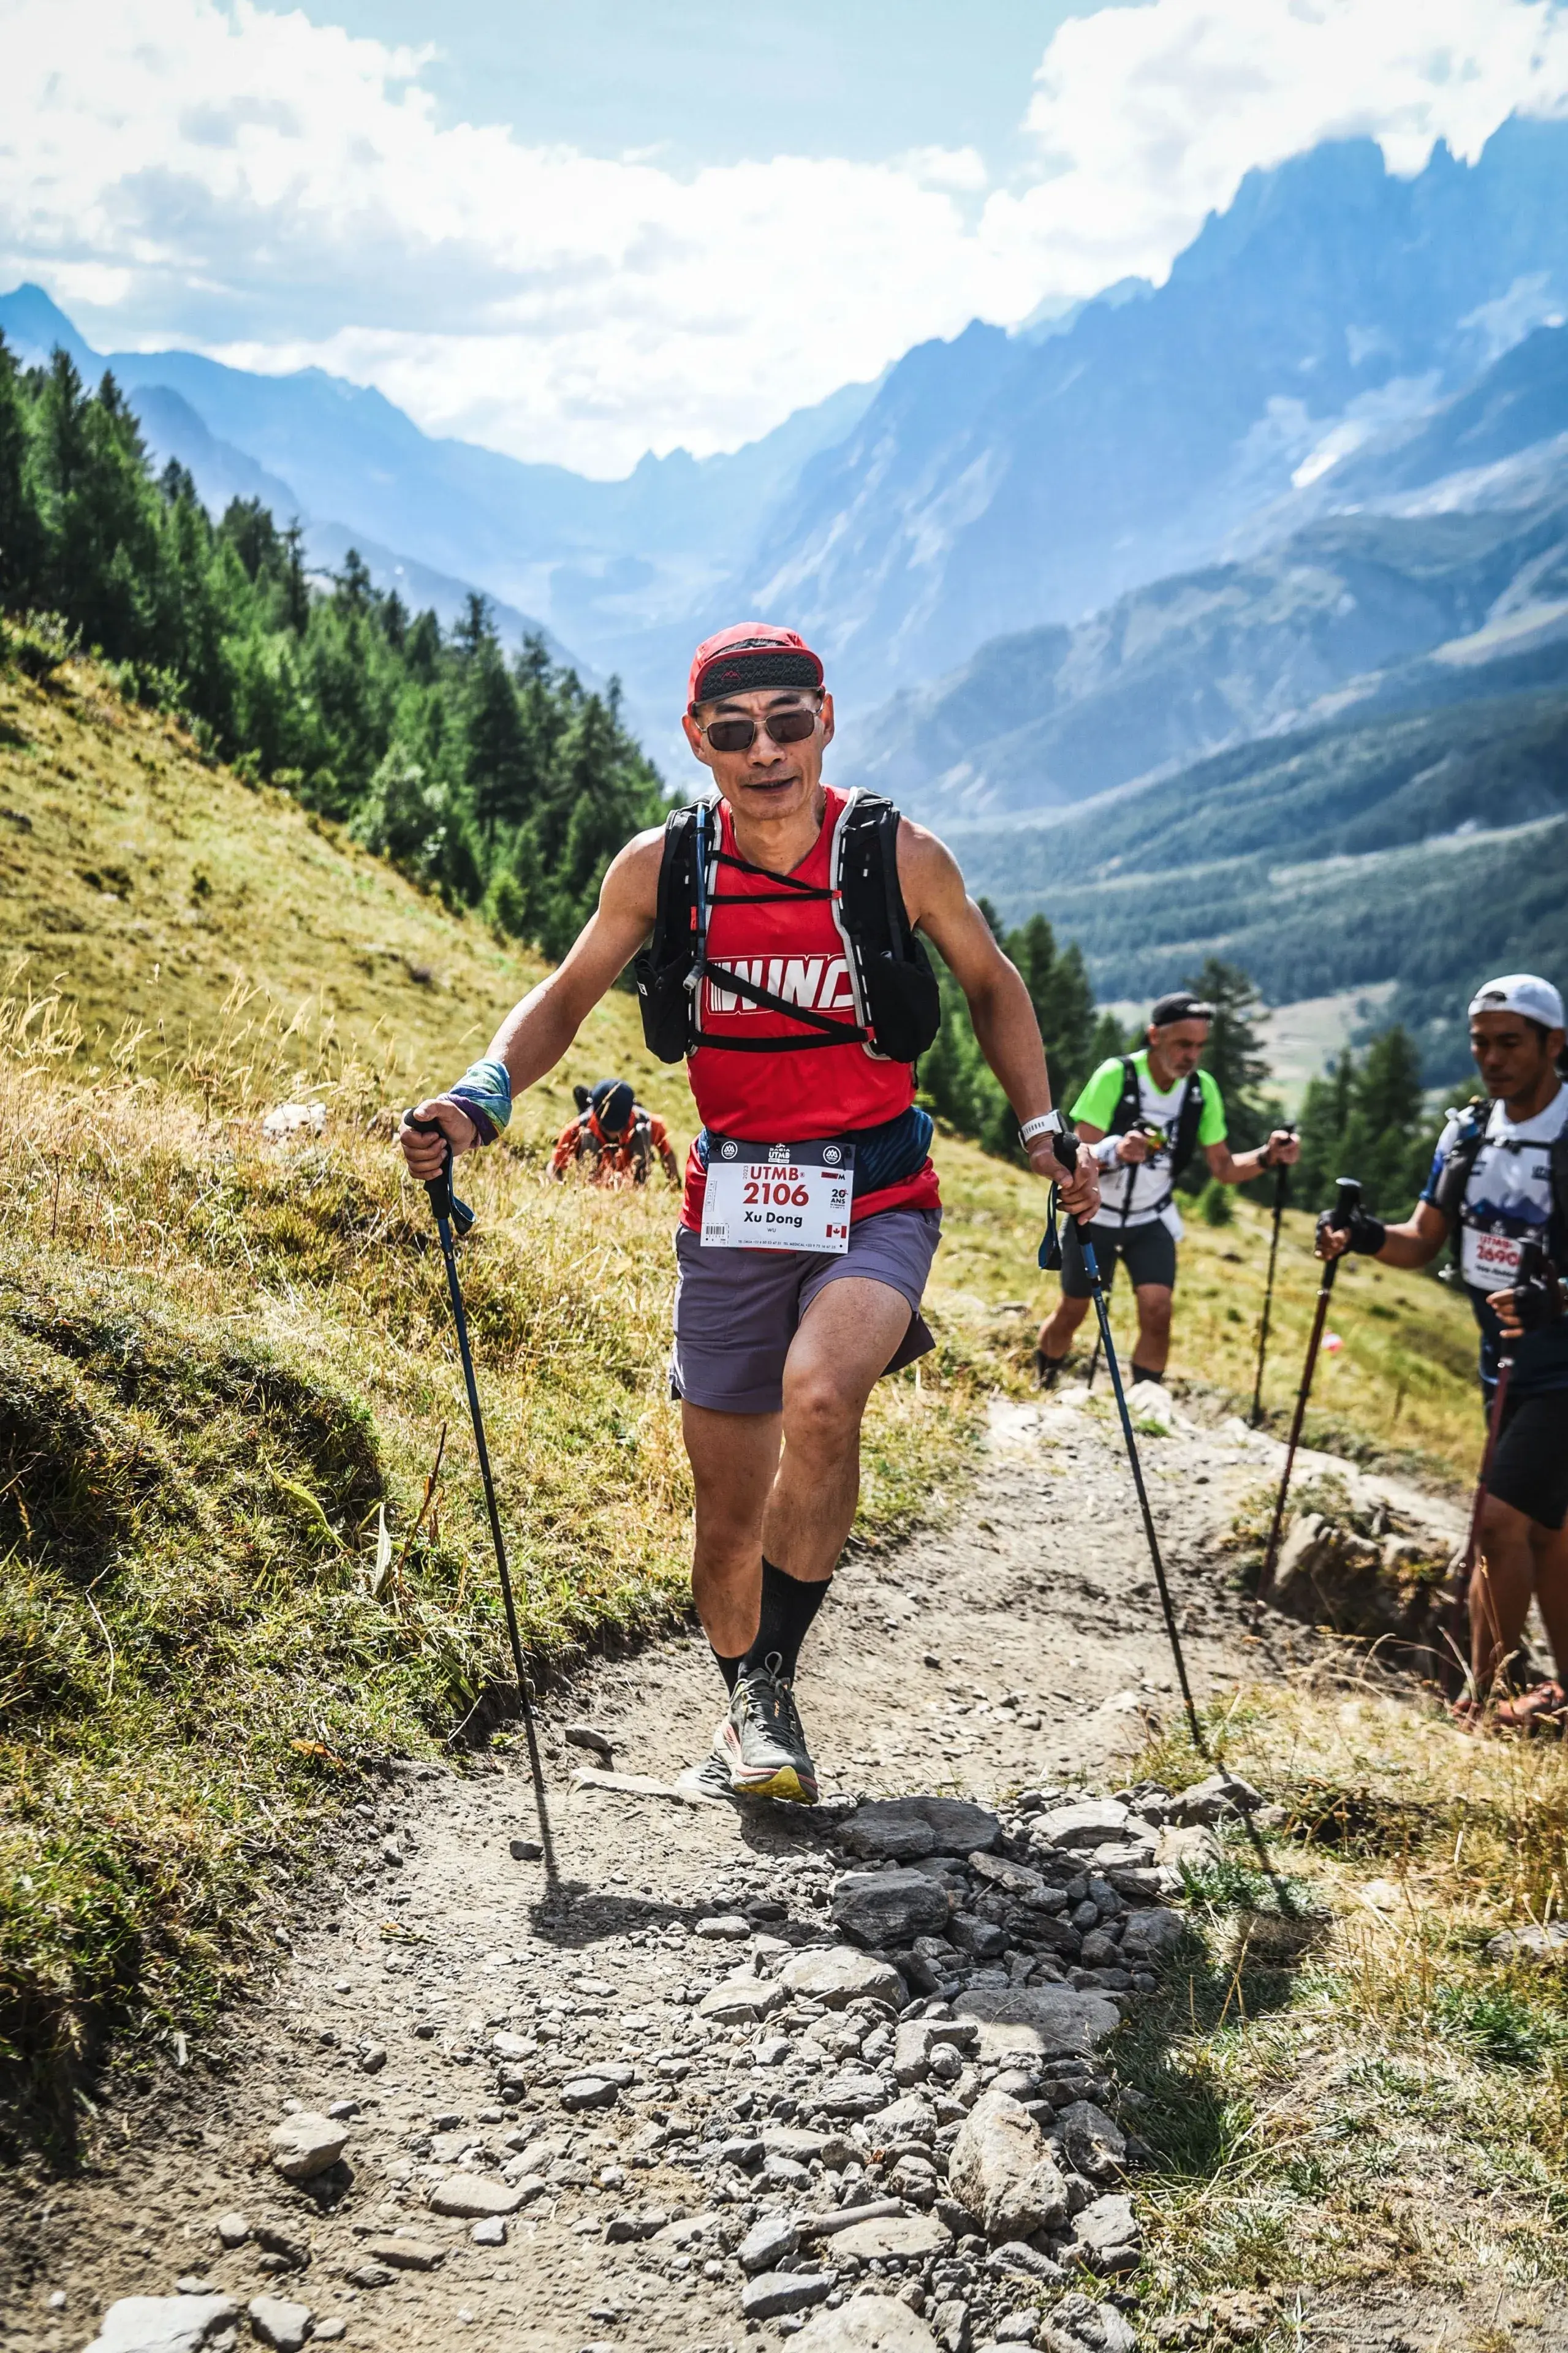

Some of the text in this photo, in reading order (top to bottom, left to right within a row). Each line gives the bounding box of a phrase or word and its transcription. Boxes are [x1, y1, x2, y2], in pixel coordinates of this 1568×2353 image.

[743, 1182, 809, 1207] 2106
[831, 1189, 846, 1198] 20
[744, 1211, 803, 1228] Xu Dong
